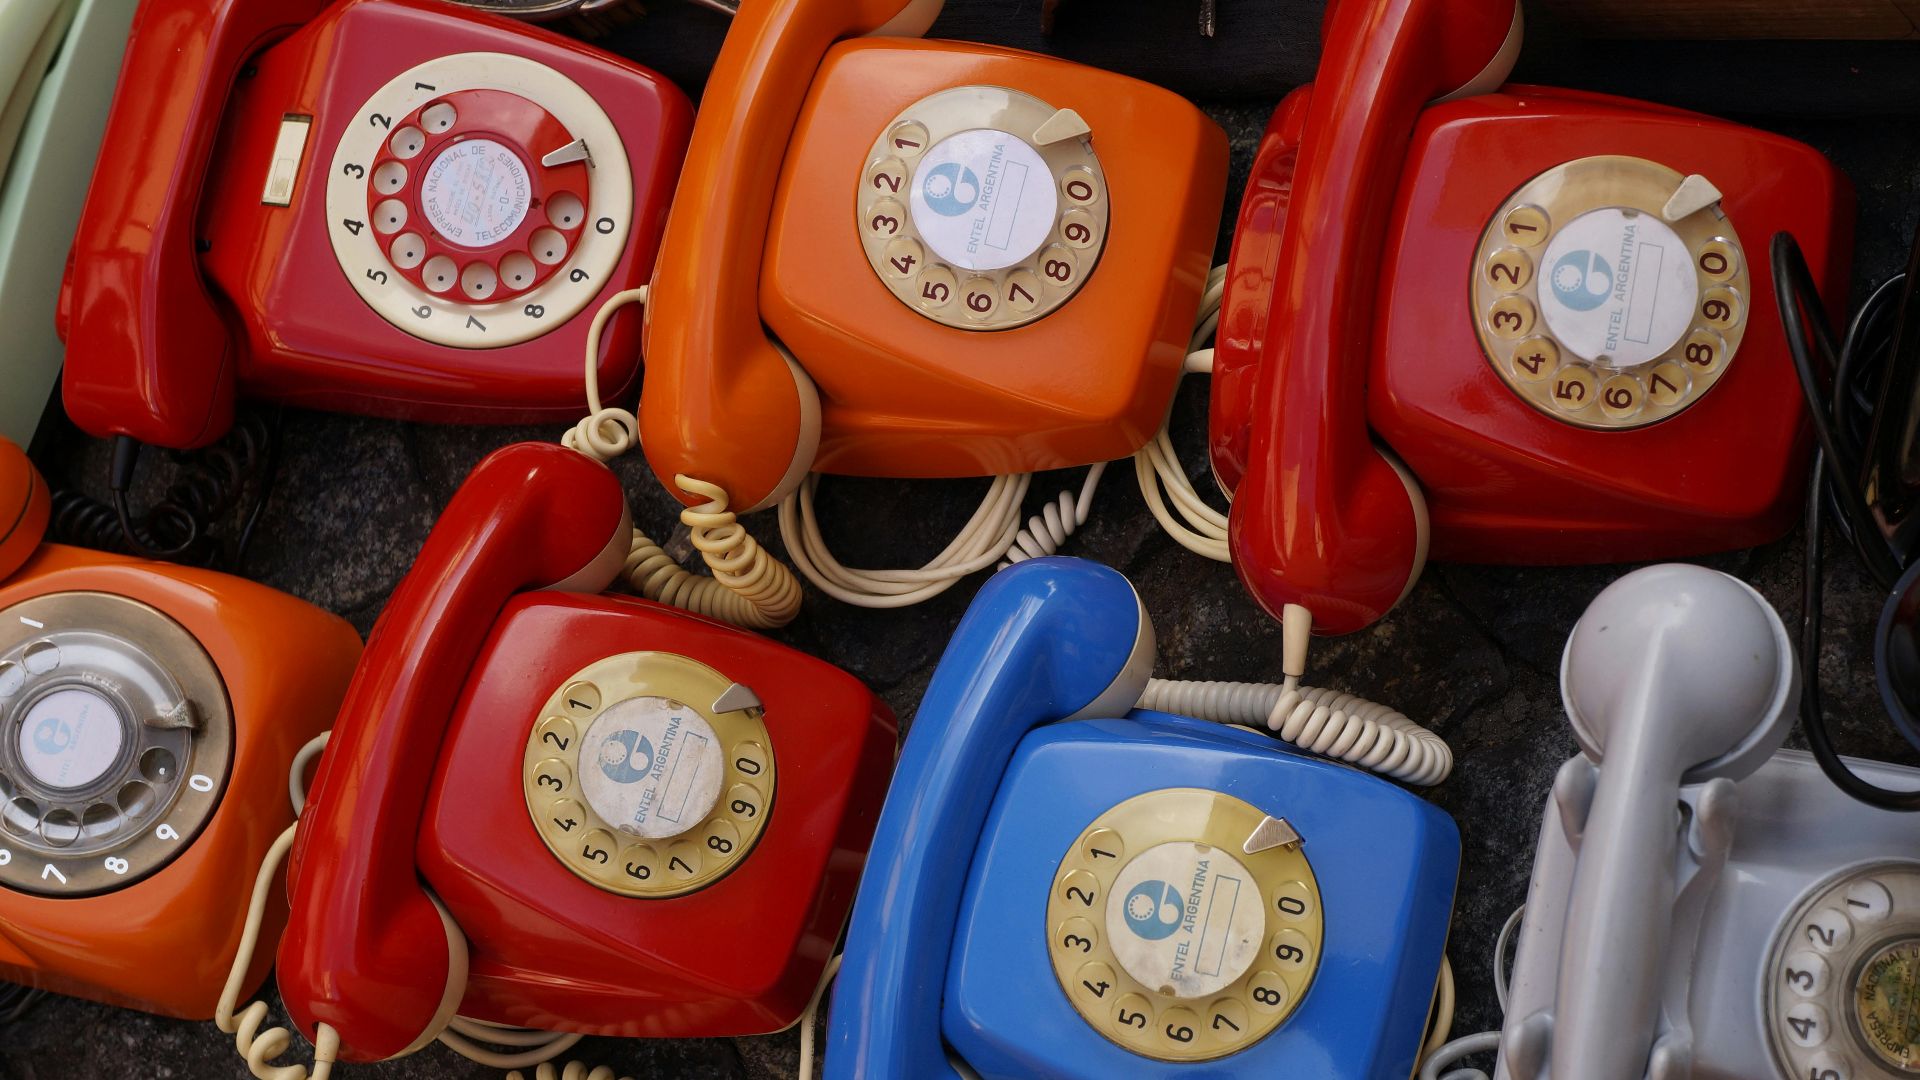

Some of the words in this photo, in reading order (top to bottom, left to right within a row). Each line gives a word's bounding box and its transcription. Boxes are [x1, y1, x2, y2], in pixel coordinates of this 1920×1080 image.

[415, 82, 435, 91] 1
[370, 113, 391, 129] 2
[472, 146, 485, 154] DE
[895, 138, 920, 149] 1
[344, 164, 364, 179] 3
[429, 149, 466, 192] NACIONAL
[874, 173, 901, 192] 2
[1067, 181, 1092, 200] 0
[475, 153, 525, 240] TELECOMUNICACIONES
[967, 216, 986, 254] ENTEL
[979, 144, 1005, 211] ARGENTINA
[429, 197, 462, 237] EMPRESA
[596, 218, 614, 234] 0
[872, 215, 898, 234] 3
[343, 219, 364, 235] 4
[1065, 223, 1090, 243] 9
[1510, 221, 1537, 234] 1
[891, 255, 916, 274] 4
[1045, 260, 1070, 281] 8
[1700, 252, 1727, 274] 0
[367, 269, 387, 284] 5
[570, 269, 589, 282] 9
[1491, 263, 1520, 284] 2
[922, 282, 949, 302] 5
[1009, 283, 1034, 303] 7
[1606, 308, 1623, 351] ENTEL
[1615, 224, 1636, 301] ARGENTINA
[412, 305, 432, 318] 6
[524, 304, 544, 318] 8
[967, 292, 992, 312] 6
[1703, 300, 1731, 321] 9
[466, 316, 486, 332] 7
[1494, 311, 1522, 331] 3
[1686, 342, 1713, 365] 8
[1517, 353, 1546, 375] 4
[1557, 379, 1586, 401] 5
[1650, 373, 1677, 394] 7
[1605, 388, 1632, 409] 6
[569, 699, 592, 710] 1
[543, 732, 569, 750] 2
[634, 785, 656, 823] ENTEL
[652, 716, 682, 781] ARGENTINA
[736, 758, 760, 775] 0
[538, 774, 563, 792] 3
[731, 799, 755, 817] 9
[42, 864, 67, 884] 7
[104, 857, 128, 874] 8
[156, 824, 179, 840] 9
[189, 774, 213, 792] 0
[554, 816, 577, 832] 4
[708, 835, 732, 853] 8
[1091, 848, 1116, 858] 1
[583, 845, 608, 864] 5
[626, 862, 650, 879] 6
[669, 857, 693, 874] 7
[1067, 887, 1094, 906] 2
[1278, 896, 1305, 915] 0
[1847, 899, 1869, 908] 1
[1171, 940, 1190, 982] ENTEL
[1183, 859, 1210, 934] ARGENTINA
[1064, 935, 1091, 952] 3
[1807, 924, 1834, 946] 2
[1276, 944, 1303, 963] 9
[1786, 968, 1813, 991] 3
[1864, 951, 1904, 1000] NACIONAL
[1083, 980, 1109, 998] 4
[1253, 987, 1280, 1005] 8
[1119, 1009, 1146, 1029] 5
[1213, 1013, 1240, 1031] 7
[1787, 1016, 1816, 1040] 4
[1166, 1024, 1193, 1042] 6
[1867, 1011, 1910, 1058] EMPRESA
